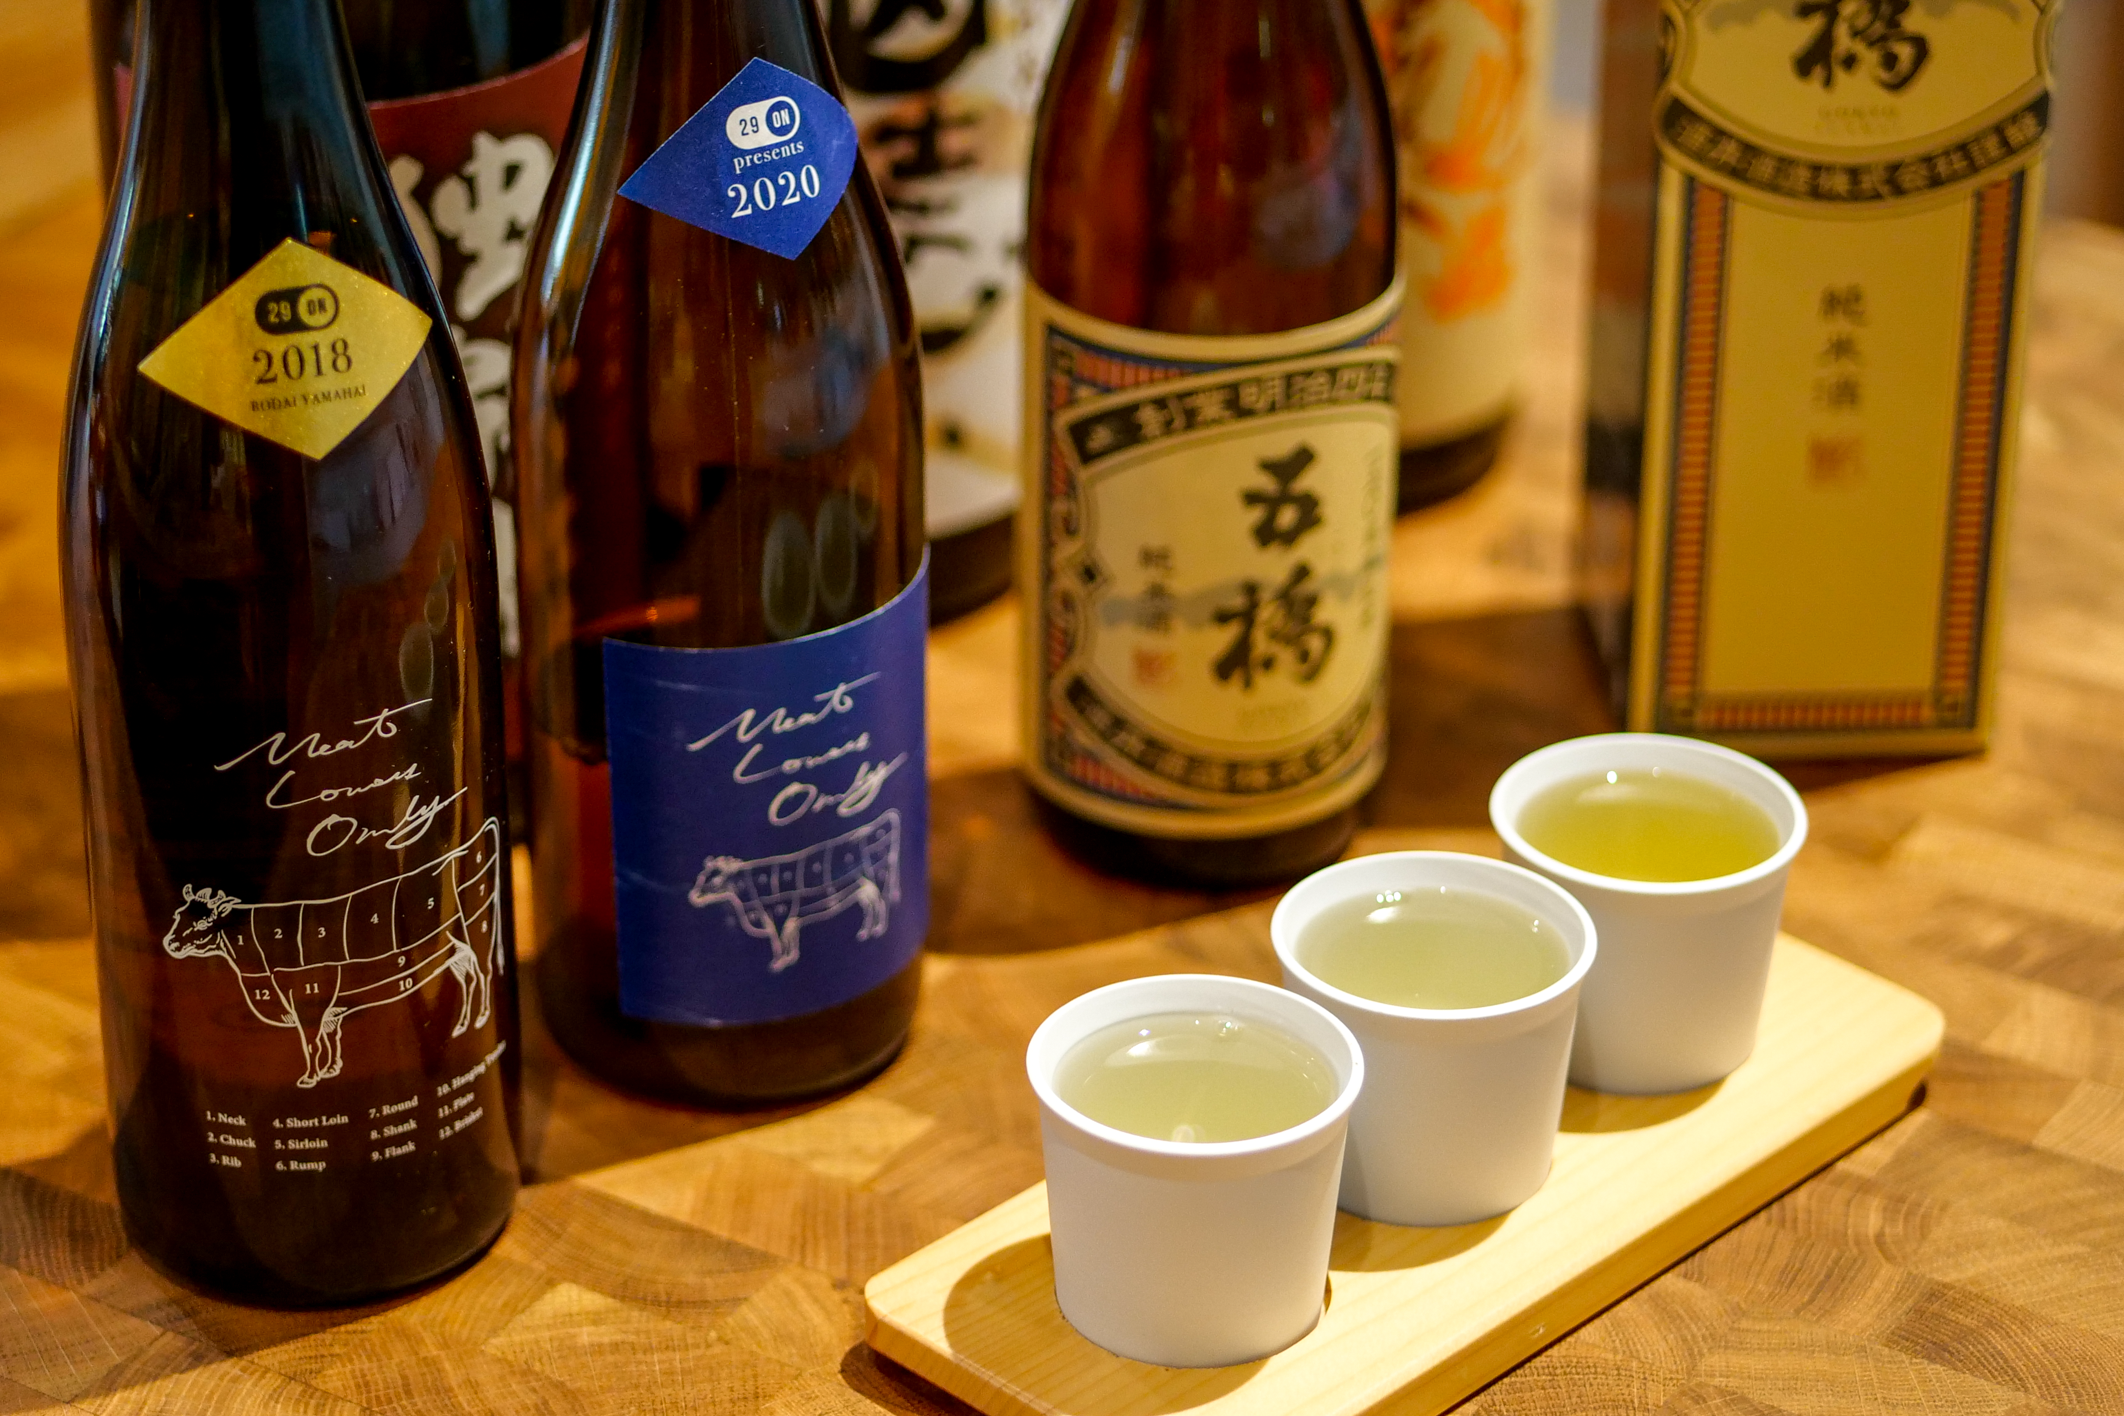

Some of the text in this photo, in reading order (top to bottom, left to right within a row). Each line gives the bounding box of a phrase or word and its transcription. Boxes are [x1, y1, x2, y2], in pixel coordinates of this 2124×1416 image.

[739, 108, 790, 136] 29 ON
[733, 140, 805, 174] presents
[727, 164, 821, 219] 2020
[267, 297, 328, 323] 29 ON
[252, 338, 353, 385] 2018
[301, 384, 367, 405] YAMAHAI
[687, 671, 881, 751] Meat
[213, 698, 433, 771] Meat
[768, 752, 908, 826] Only
[307, 786, 468, 856] Only
[254, 989, 271, 1000] 12
[305, 983, 320, 994] 11
[399, 978, 413, 990] 10
[206, 1110, 246, 1126] 1. Neck
[368, 1095, 419, 1119] 7. Round
[272, 1114, 349, 1129] 4. Short Loin
[370, 1118, 418, 1140] 8. Shank
[207, 1132, 256, 1148] 2. Chuck
[274, 1138, 328, 1150] 5. Sirloin
[371, 1140, 416, 1162] 9. Flank
[209, 1153, 242, 1168] 3. Rib
[275, 1160, 326, 1172] 6. Rump
